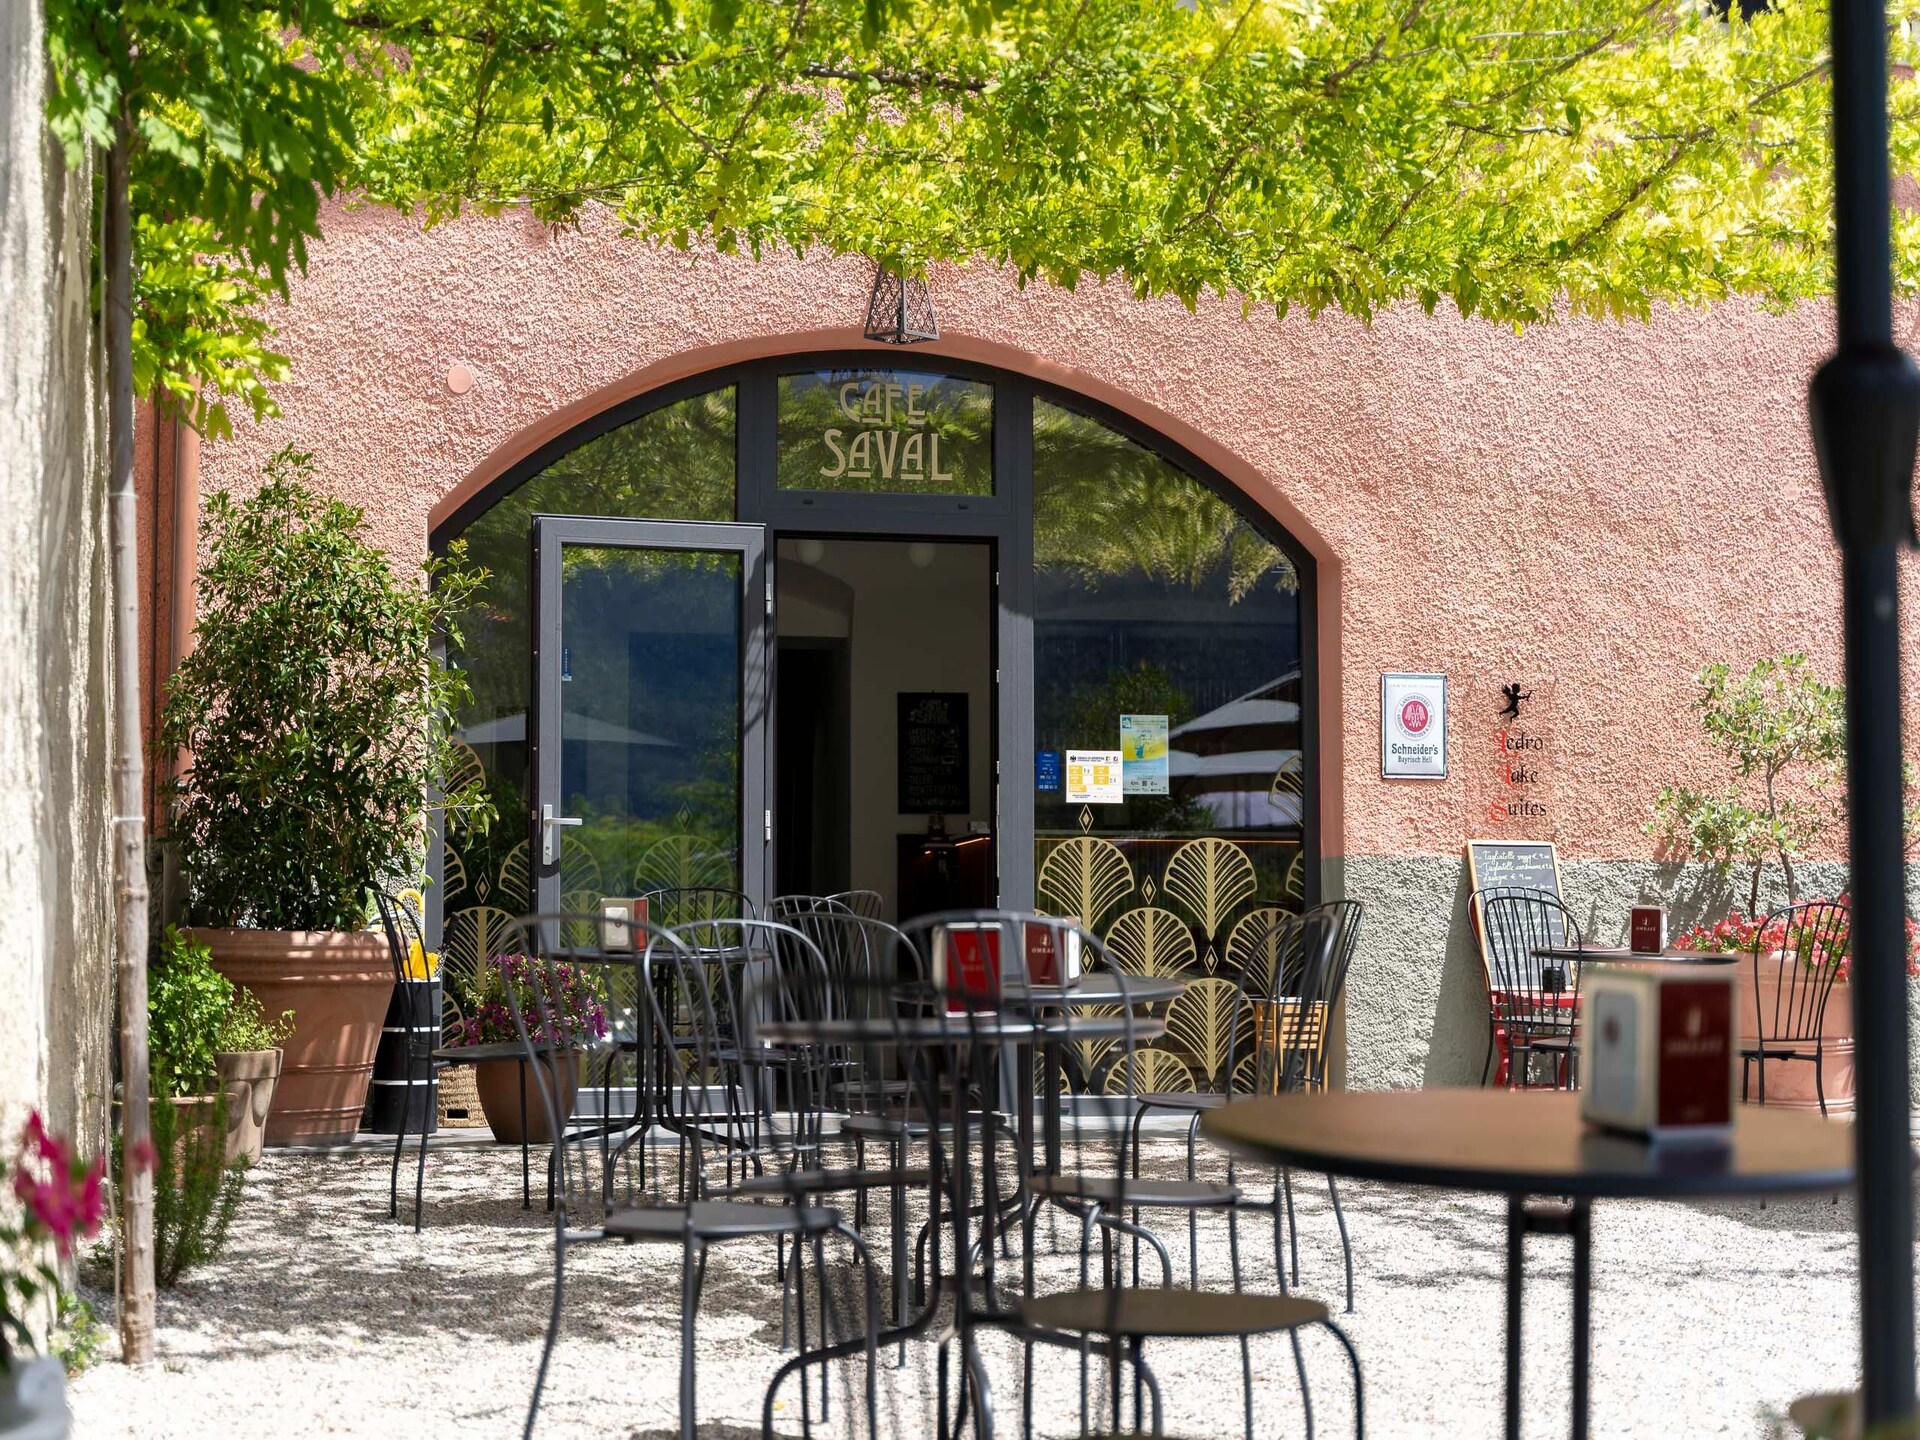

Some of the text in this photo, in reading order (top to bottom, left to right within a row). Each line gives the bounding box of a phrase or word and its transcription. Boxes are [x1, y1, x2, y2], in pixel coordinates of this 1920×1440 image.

[819, 428, 953, 481] SAVAL
[1391, 743, 1439, 755] Schneider's
[1490, 797, 1547, 822] Suites
